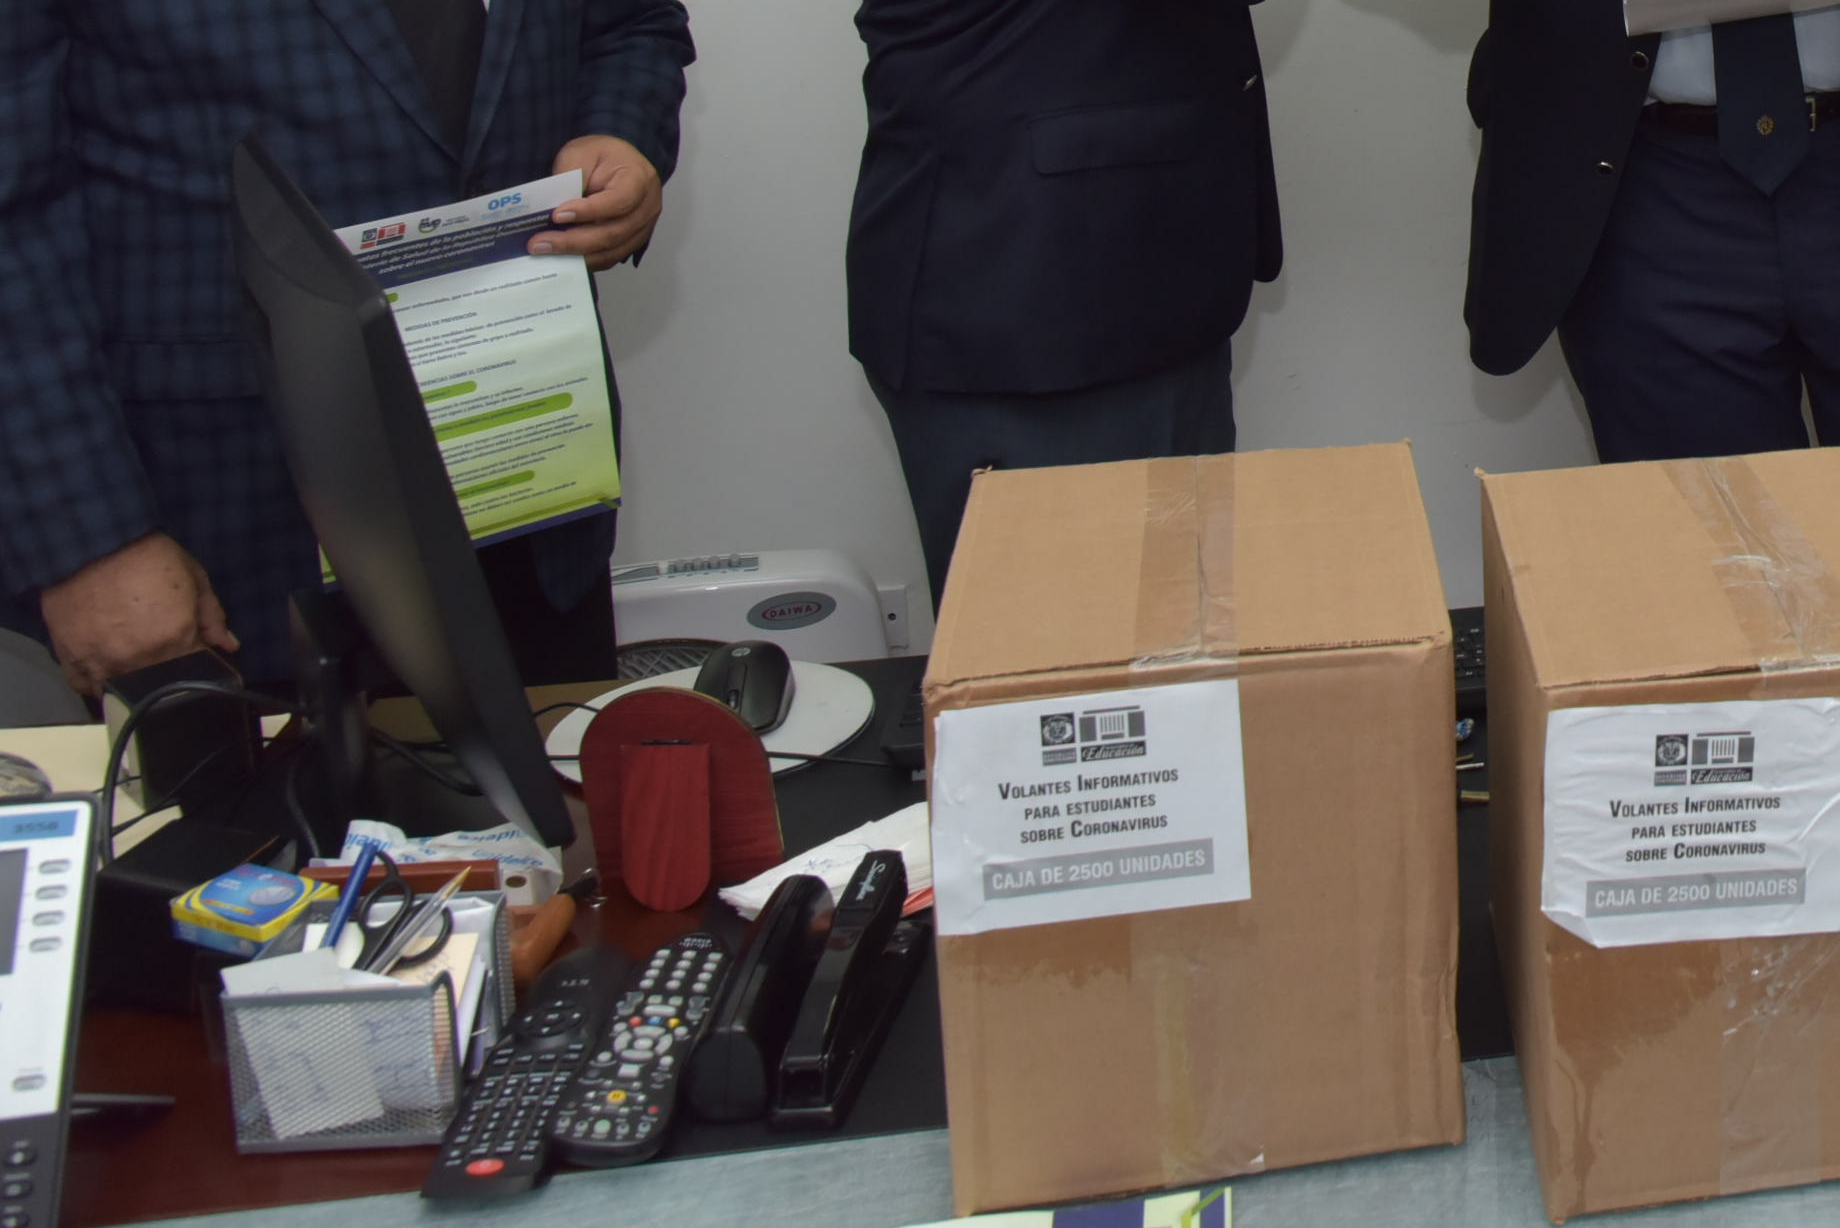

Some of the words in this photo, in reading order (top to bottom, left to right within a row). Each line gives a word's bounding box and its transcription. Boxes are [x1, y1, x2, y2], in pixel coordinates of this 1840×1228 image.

[487, 193, 522, 210] OPS
[769, 604, 813, 618] DAIWA
[998, 782, 1071, 800] VOLANTES
[1077, 769, 1179, 791] INFORMATIVOS
[1024, 806, 1060, 820] PARA
[1066, 794, 1156, 816] ESTUDIANTES
[1610, 800, 1678, 818] VOLANTES
[1685, 796, 1781, 813] INFORMATIVOS
[1020, 828, 1065, 844] SOBRE
[1070, 815, 1168, 838] CORONAVIRUS
[1631, 826, 1665, 840] PARA
[1672, 820, 1756, 837] ESTUDIANTES
[1625, 848, 1667, 862] SOBRE
[1673, 842, 1766, 860] CORONAVIRUS
[992, 870, 1035, 890] CAJA
[1041, 867, 1064, 885] DE
[1069, 861, 1114, 880] 2500
[1120, 849, 1206, 875] UNIDADES
[1595, 889, 1636, 907] CAJA
[1641, 887, 1662, 904] DE
[1667, 884, 1710, 902] 2500
[1716, 878, 1798, 899] UNIDADES
